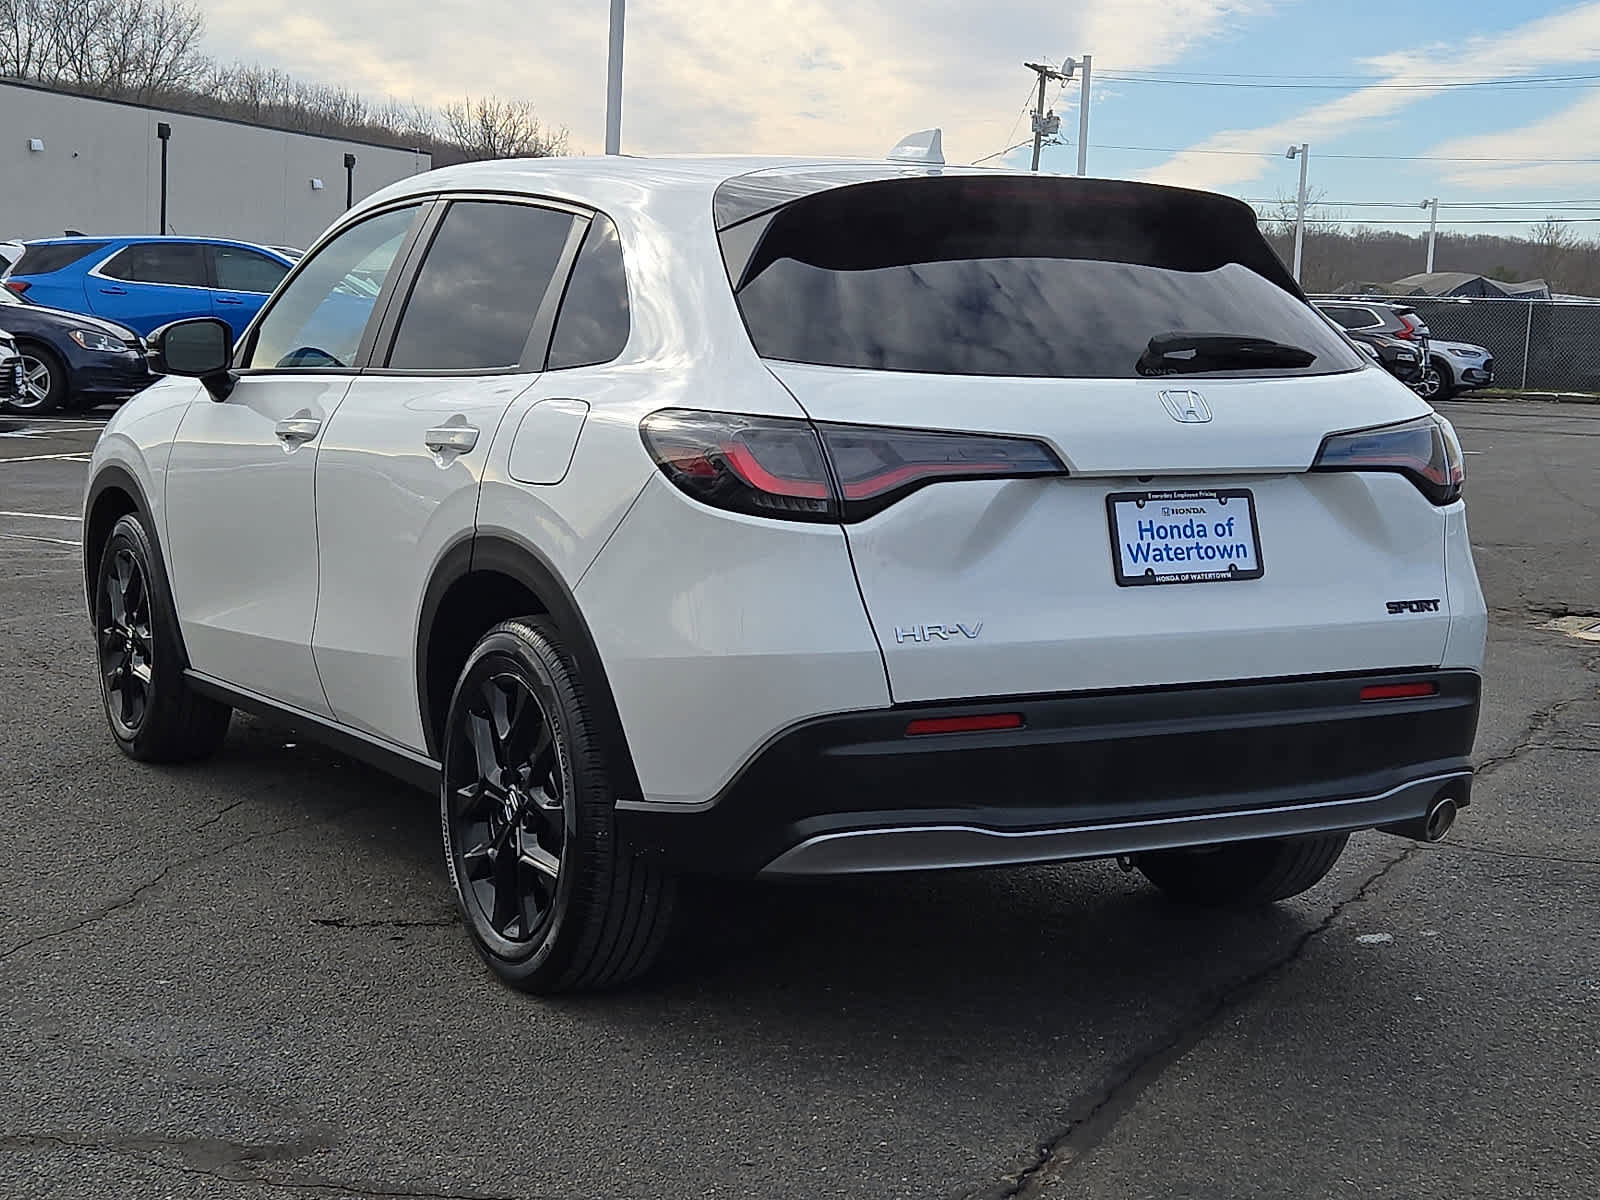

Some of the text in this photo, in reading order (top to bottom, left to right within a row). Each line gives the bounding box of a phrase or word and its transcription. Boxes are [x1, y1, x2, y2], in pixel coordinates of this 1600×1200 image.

[1171, 507, 1207, 515] HONDA
[1137, 517, 1235, 541] Honda of
[1126, 541, 1248, 564] Watertown
[1156, 571, 1232, 583] HONDA OF WATERTOWN
[1385, 598, 1441, 615] SPORT
[894, 621, 984, 644] HR-V
